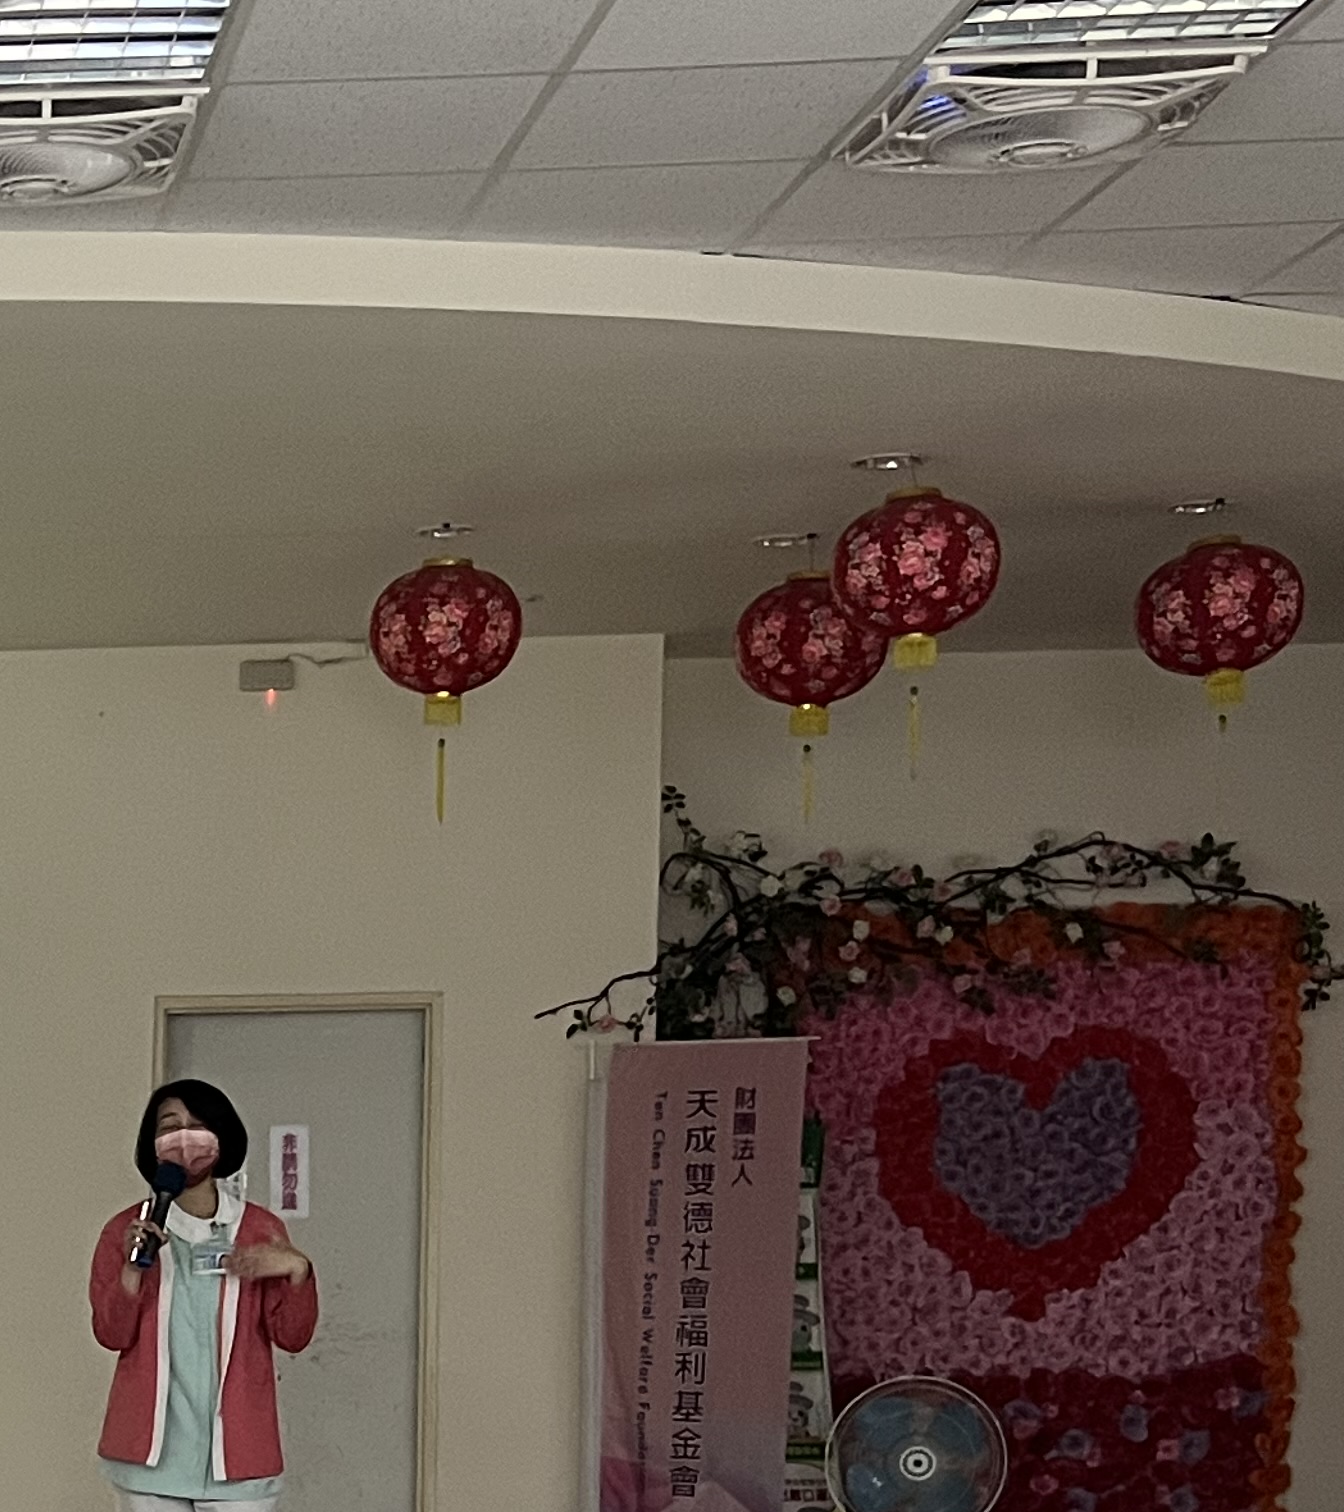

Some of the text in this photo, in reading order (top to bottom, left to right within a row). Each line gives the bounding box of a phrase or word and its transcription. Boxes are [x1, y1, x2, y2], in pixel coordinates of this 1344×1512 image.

[731, 1086, 757, 1188] 財團法人
[642, 1272, 658, 1320] Social
[669, 1089, 718, 1498] 天成雙德社會福利基金會
[637, 1328, 655, 1395] Welfare
